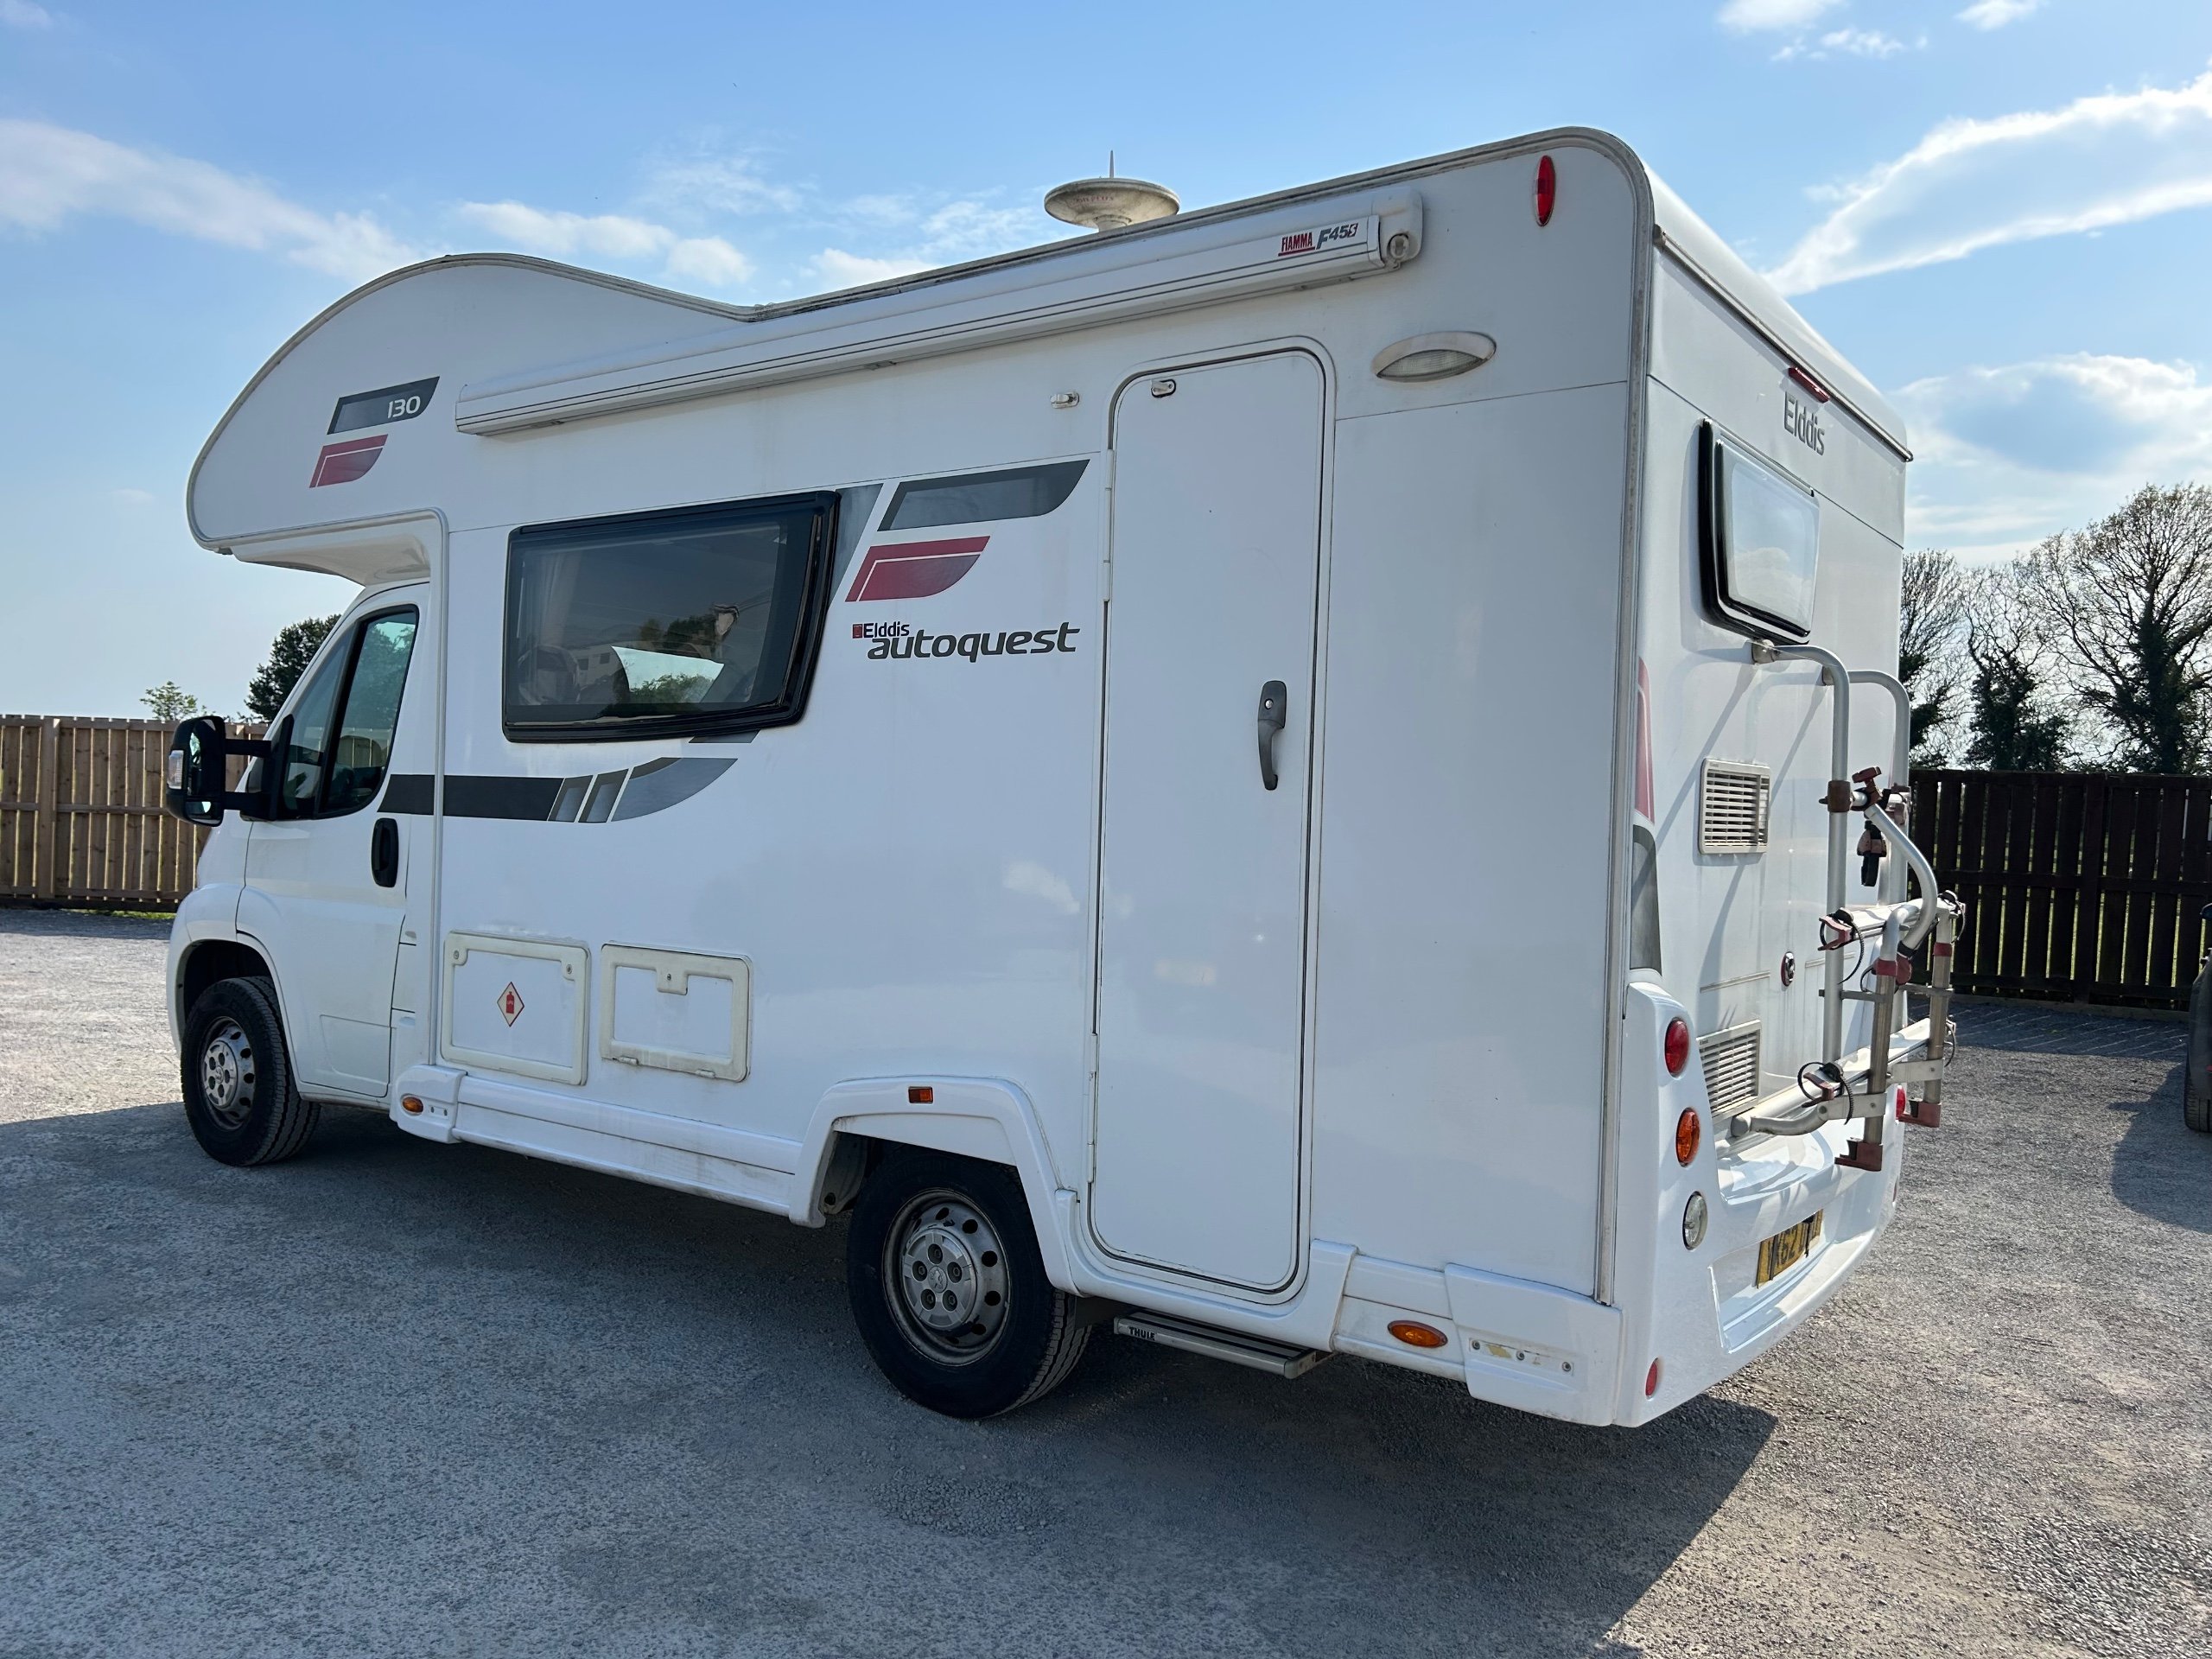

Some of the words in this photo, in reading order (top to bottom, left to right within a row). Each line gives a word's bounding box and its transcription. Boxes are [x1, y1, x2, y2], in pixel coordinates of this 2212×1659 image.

[1281, 232, 1313, 252] FIAMMA
[387, 396, 421, 419] 130
[1784, 391, 1825, 456] Elddis
[863, 621, 911, 639] Elddis
[867, 621, 1080, 663] autoquest
[1128, 1326, 1155, 1341] THULE
